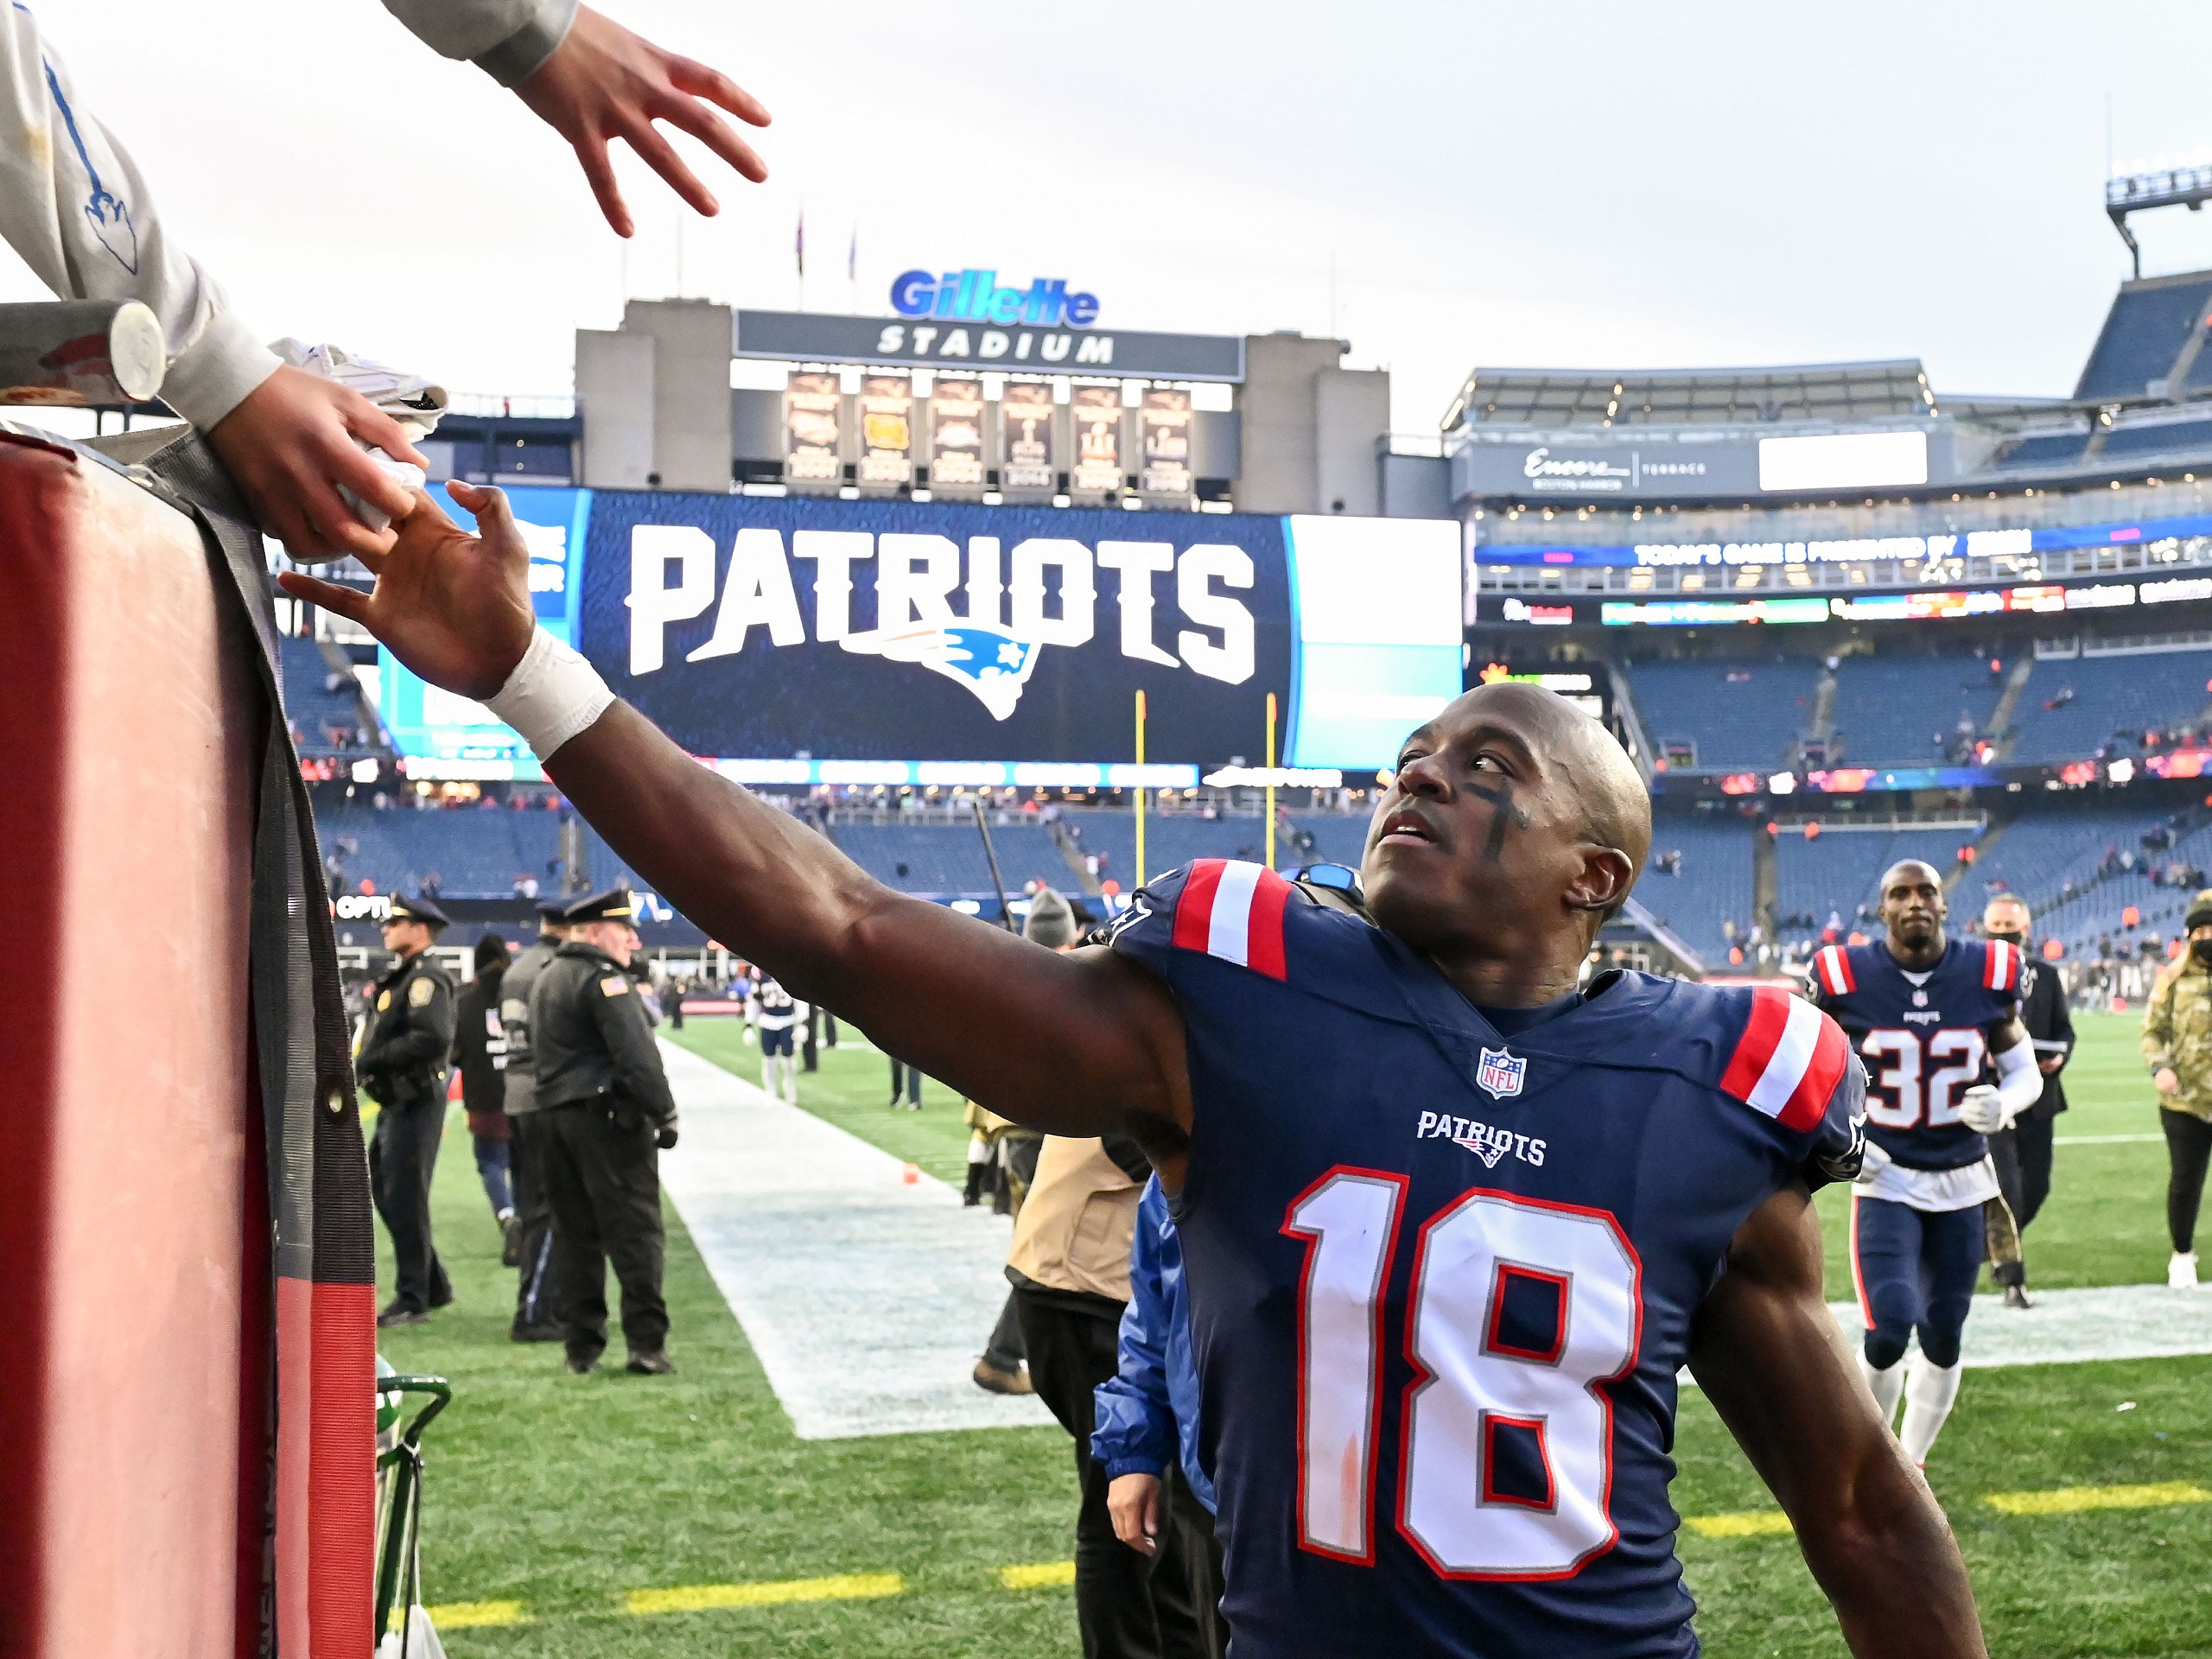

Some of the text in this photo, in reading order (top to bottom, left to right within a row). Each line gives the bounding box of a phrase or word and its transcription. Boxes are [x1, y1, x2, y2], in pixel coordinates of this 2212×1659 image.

[890, 269, 1100, 329] Gillette
[877, 325, 1114, 365] STADIUM
[624, 524, 1255, 685] PATRIOTS
[1484, 1067, 1515, 1090] NFL
[1862, 1027, 1986, 1130] 32
[1417, 1110, 1547, 1166] PATRIOTS
[1279, 1164, 1643, 1581] 18
